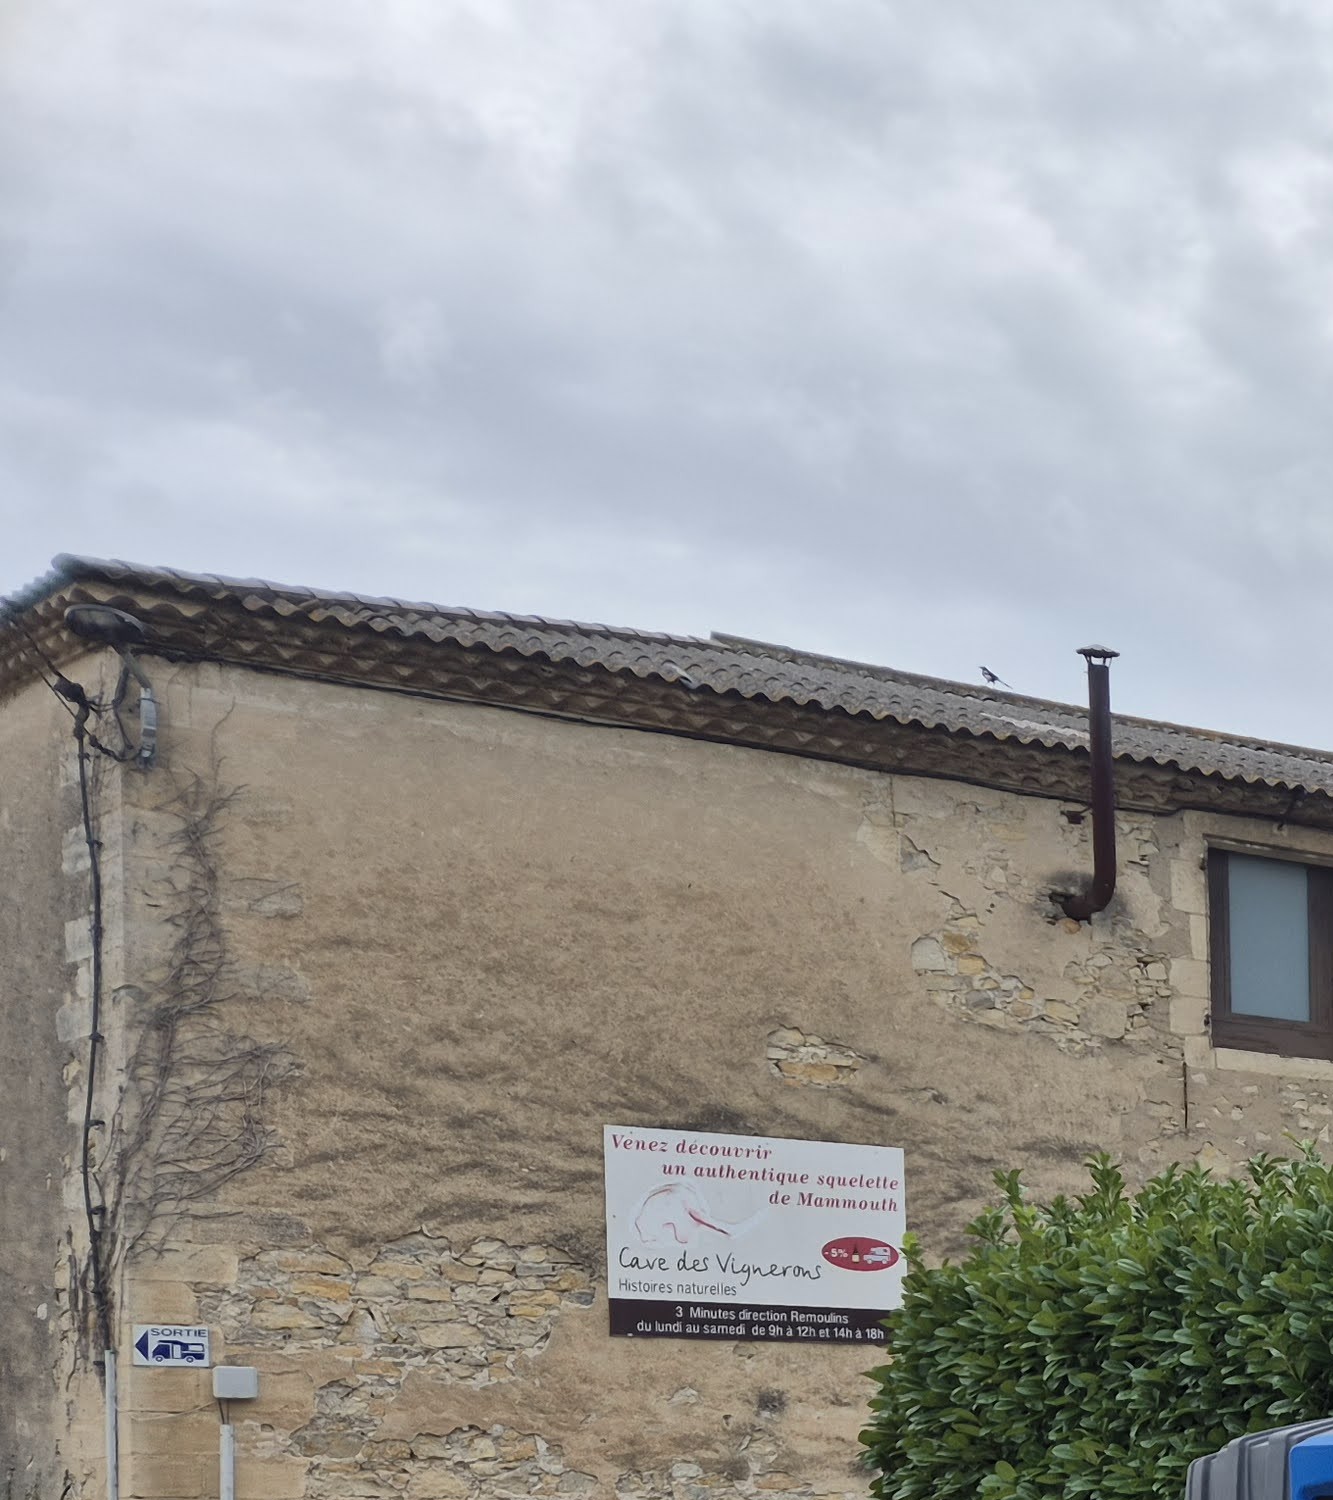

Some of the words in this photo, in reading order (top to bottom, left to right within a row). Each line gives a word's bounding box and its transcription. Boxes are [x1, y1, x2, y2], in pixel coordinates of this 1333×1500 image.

[611, 1133, 669, 1153] Venez
[676, 1138, 772, 1160] découvrir
[662, 1163, 686, 1176] un
[694, 1165, 810, 1187] authentique
[817, 1173, 899, 1191] squelette
[769, 1191, 791, 1205] de
[796, 1191, 899, 1212] Mammouth
[619, 1246, 670, 1272] Cave
[677, 1250, 710, 1272] des
[716, 1253, 822, 1287] Vignerons
[618, 1279, 673, 1294] Histoires
[677, 1281, 737, 1296] naturelles
[675, 1306, 684, 1318] 3
[690, 1306, 736, 1320] Minutes
[738, 1308, 787, 1322] direction
[790, 1311, 849, 1324] Remoulins
[151, 1328, 207, 1338] SORTIE
[637, 1321, 651, 1331] du
[655, 1320, 682, 1333] lundi
[686, 1324, 700, 1333] au
[703, 1322, 746, 1335] samedi
[752, 1324, 765, 1335] de
[768, 1325, 783, 1337] 9h
[786, 1326, 793, 1337] à
[796, 1326, 816, 1337] 12h
[819, 1328, 830, 1338] et
[833, 1327, 852, 1339] 14h
[856, 1328, 862, 1339] à
[865, 1328, 884, 1340] 18h
